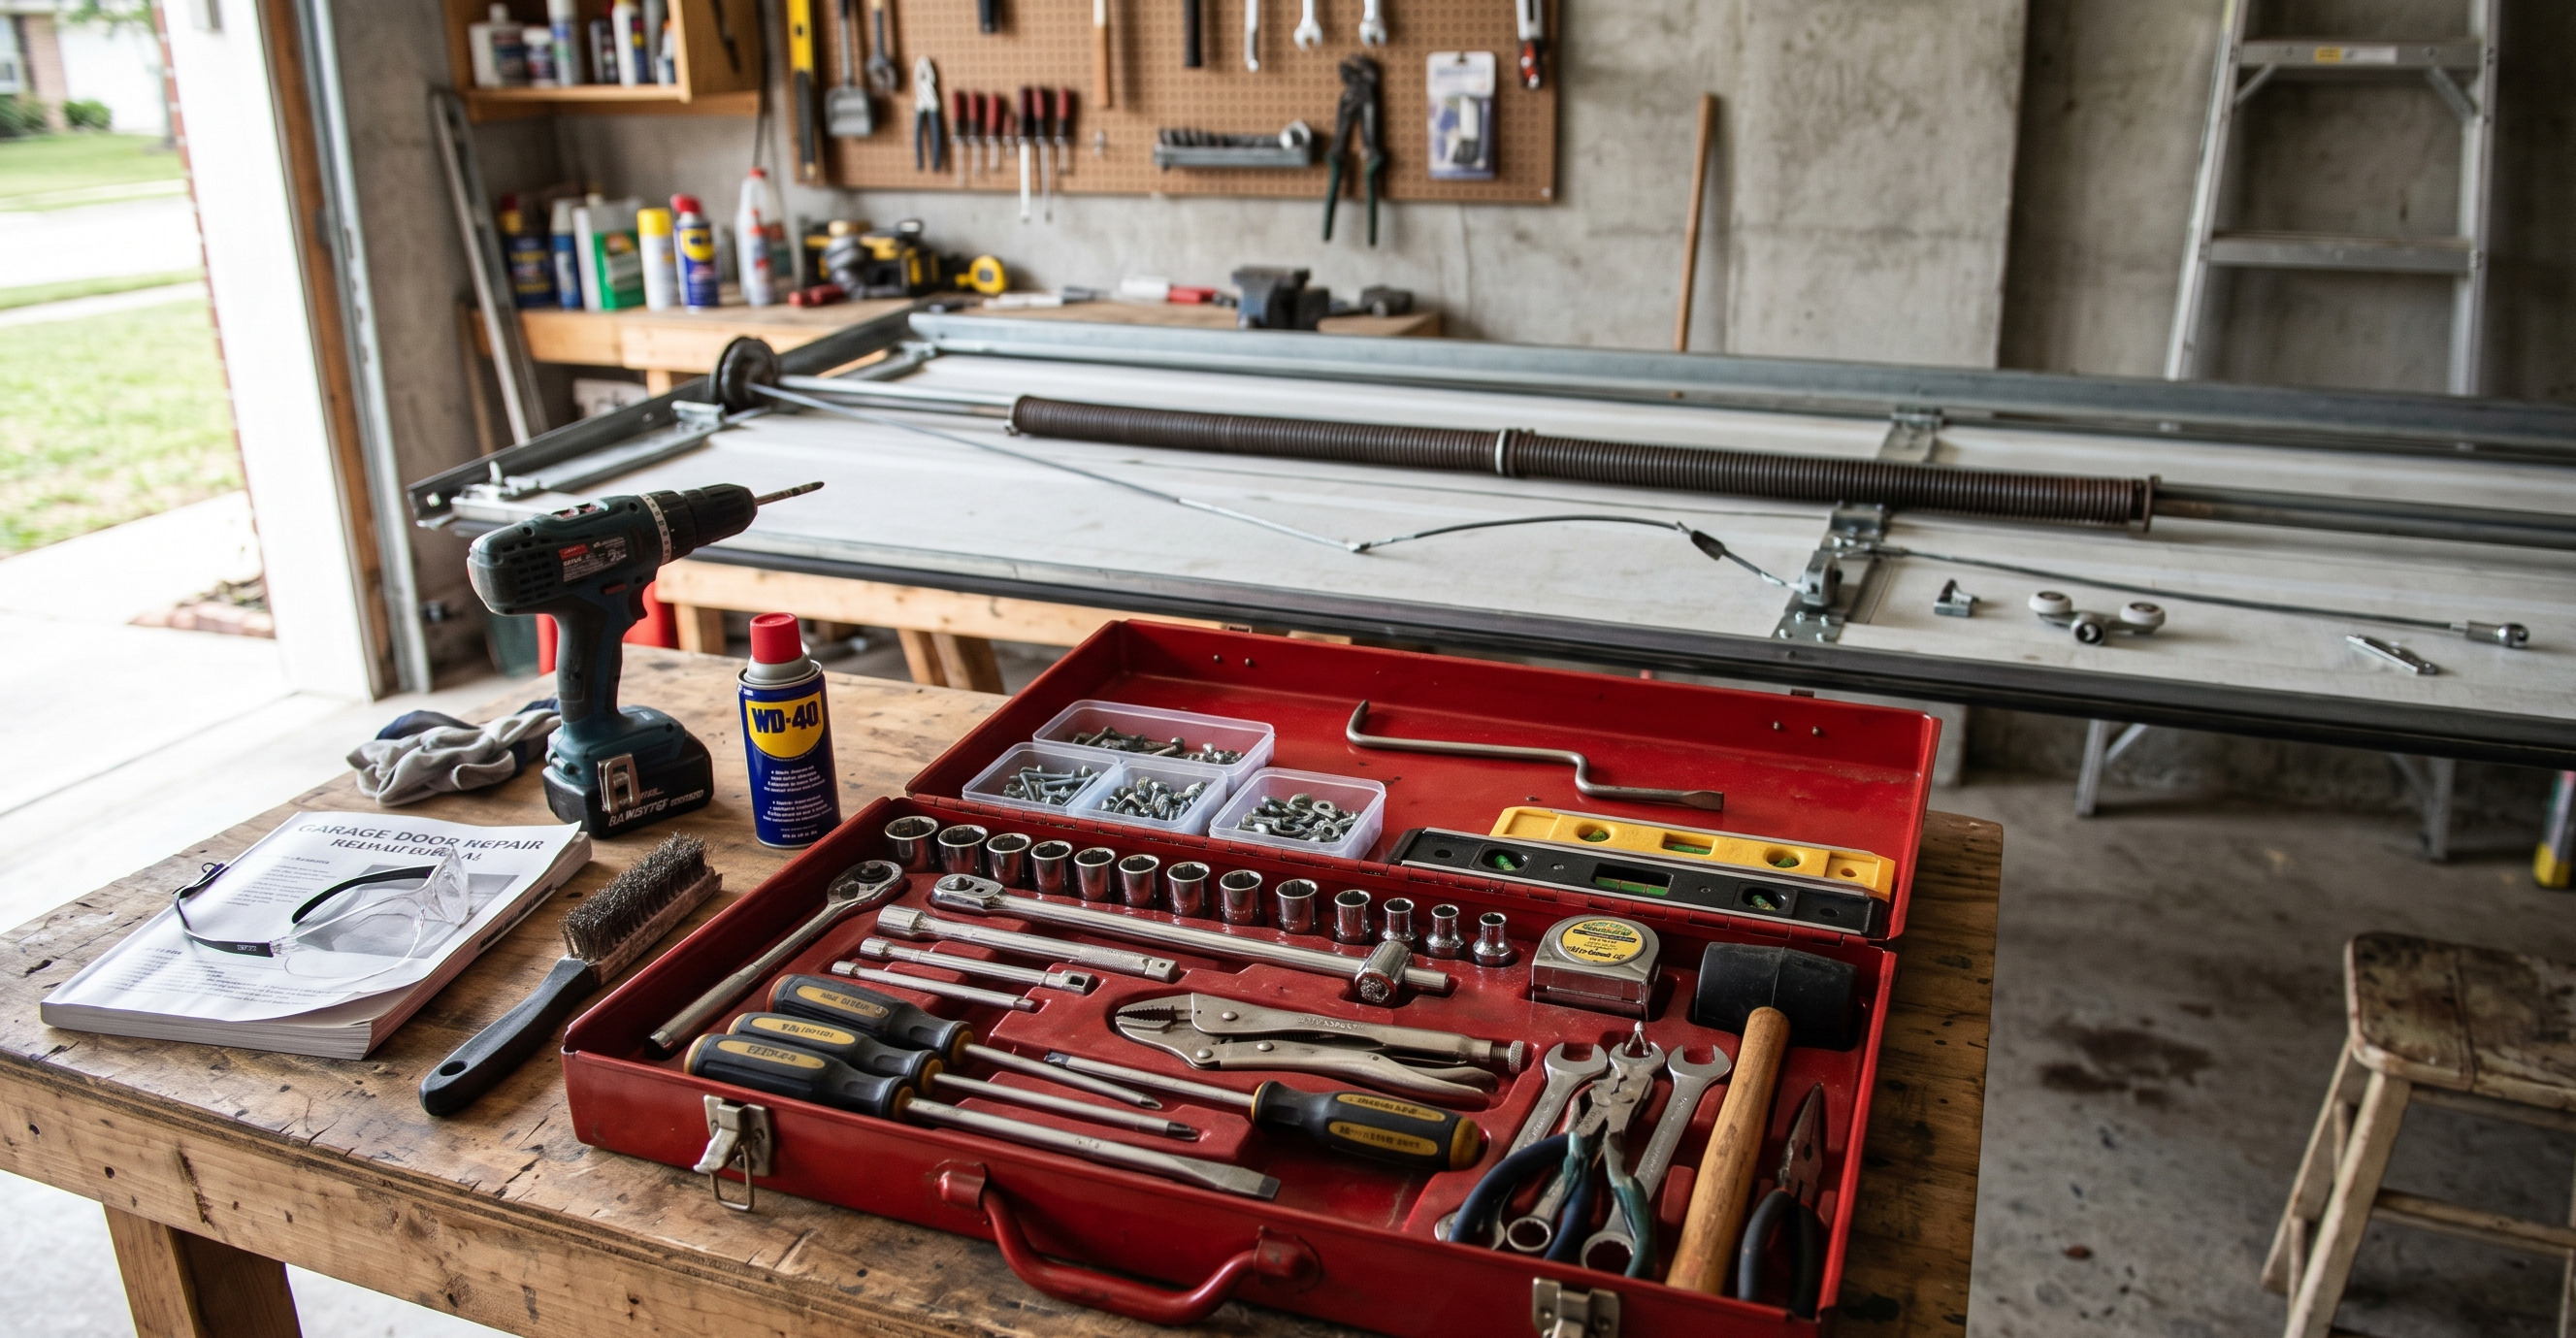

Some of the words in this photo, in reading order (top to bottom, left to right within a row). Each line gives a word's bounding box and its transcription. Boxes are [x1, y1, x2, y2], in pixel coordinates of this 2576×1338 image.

[751, 701, 819, 734] WD-40
[298, 824, 392, 840] GARAGE
[392, 831, 460, 846] DOOR
